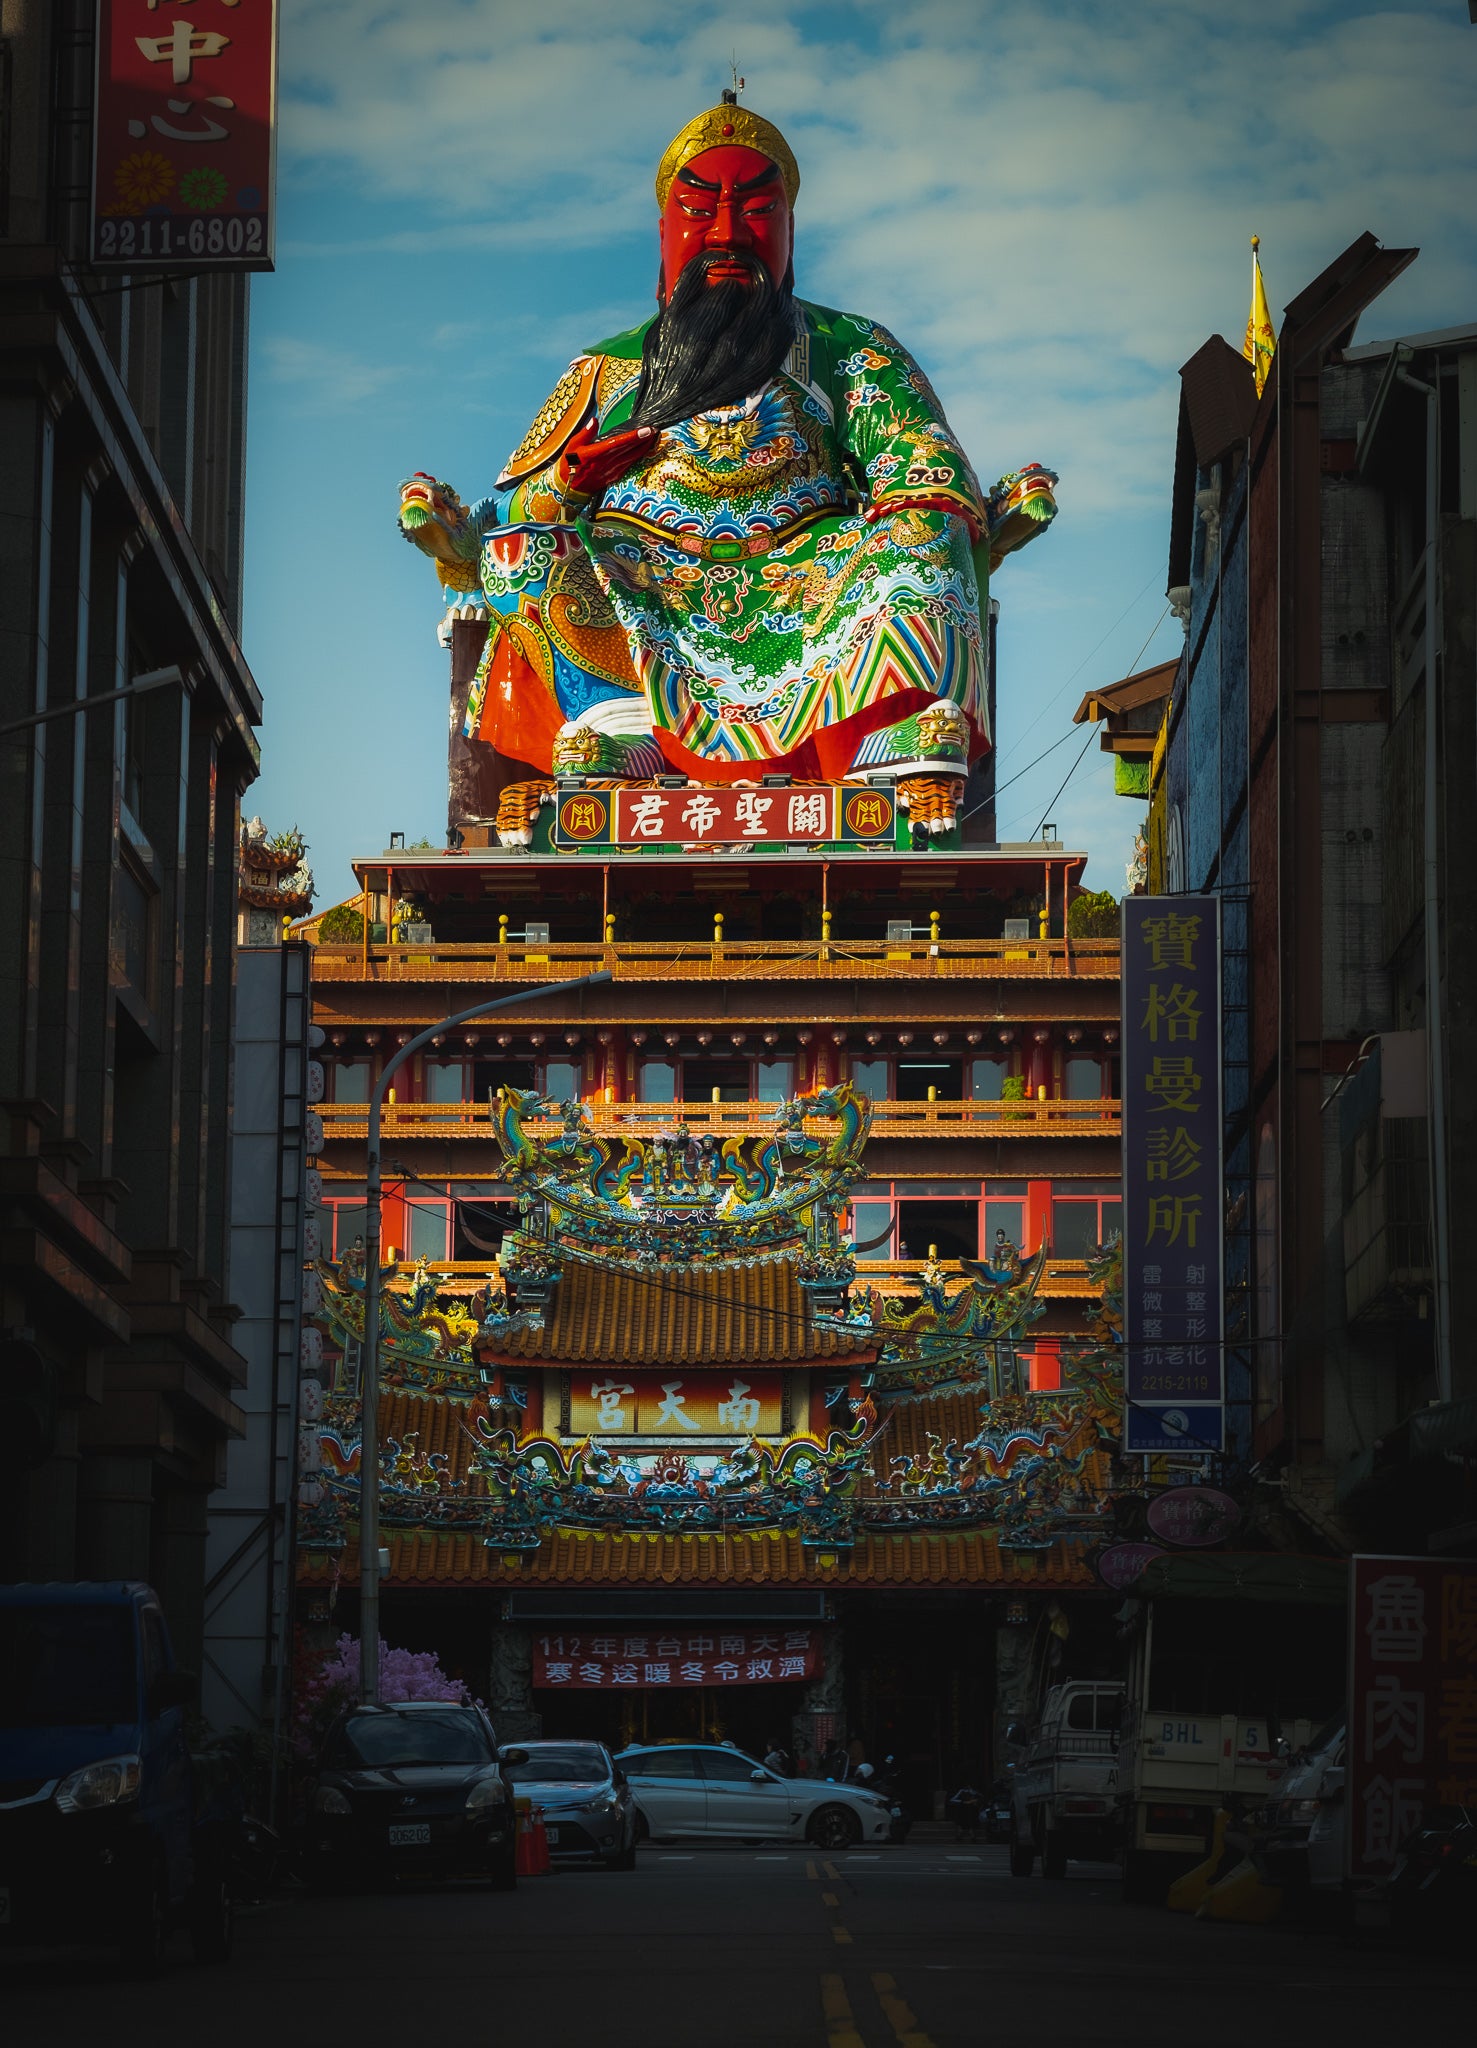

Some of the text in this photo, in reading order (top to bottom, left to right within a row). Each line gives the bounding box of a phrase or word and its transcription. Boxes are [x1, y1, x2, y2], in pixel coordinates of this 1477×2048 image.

[128, 0, 240, 142] 中心
[100, 217, 262, 256] 2211-6802
[1140, 912, 1204, 1248] 寶格曼診所
[1142, 1345, 1207, 1366] 抗老化
[1141, 1375, 1208, 1391] 2215-2119
[590, 1378, 761, 1430] 南天宮
[545, 1655, 806, 1684] 寒冬送暖冬令救濟
[1162, 1722, 1203, 1744] BHL
[1362, 1574, 1428, 1864] 魯肉飯
